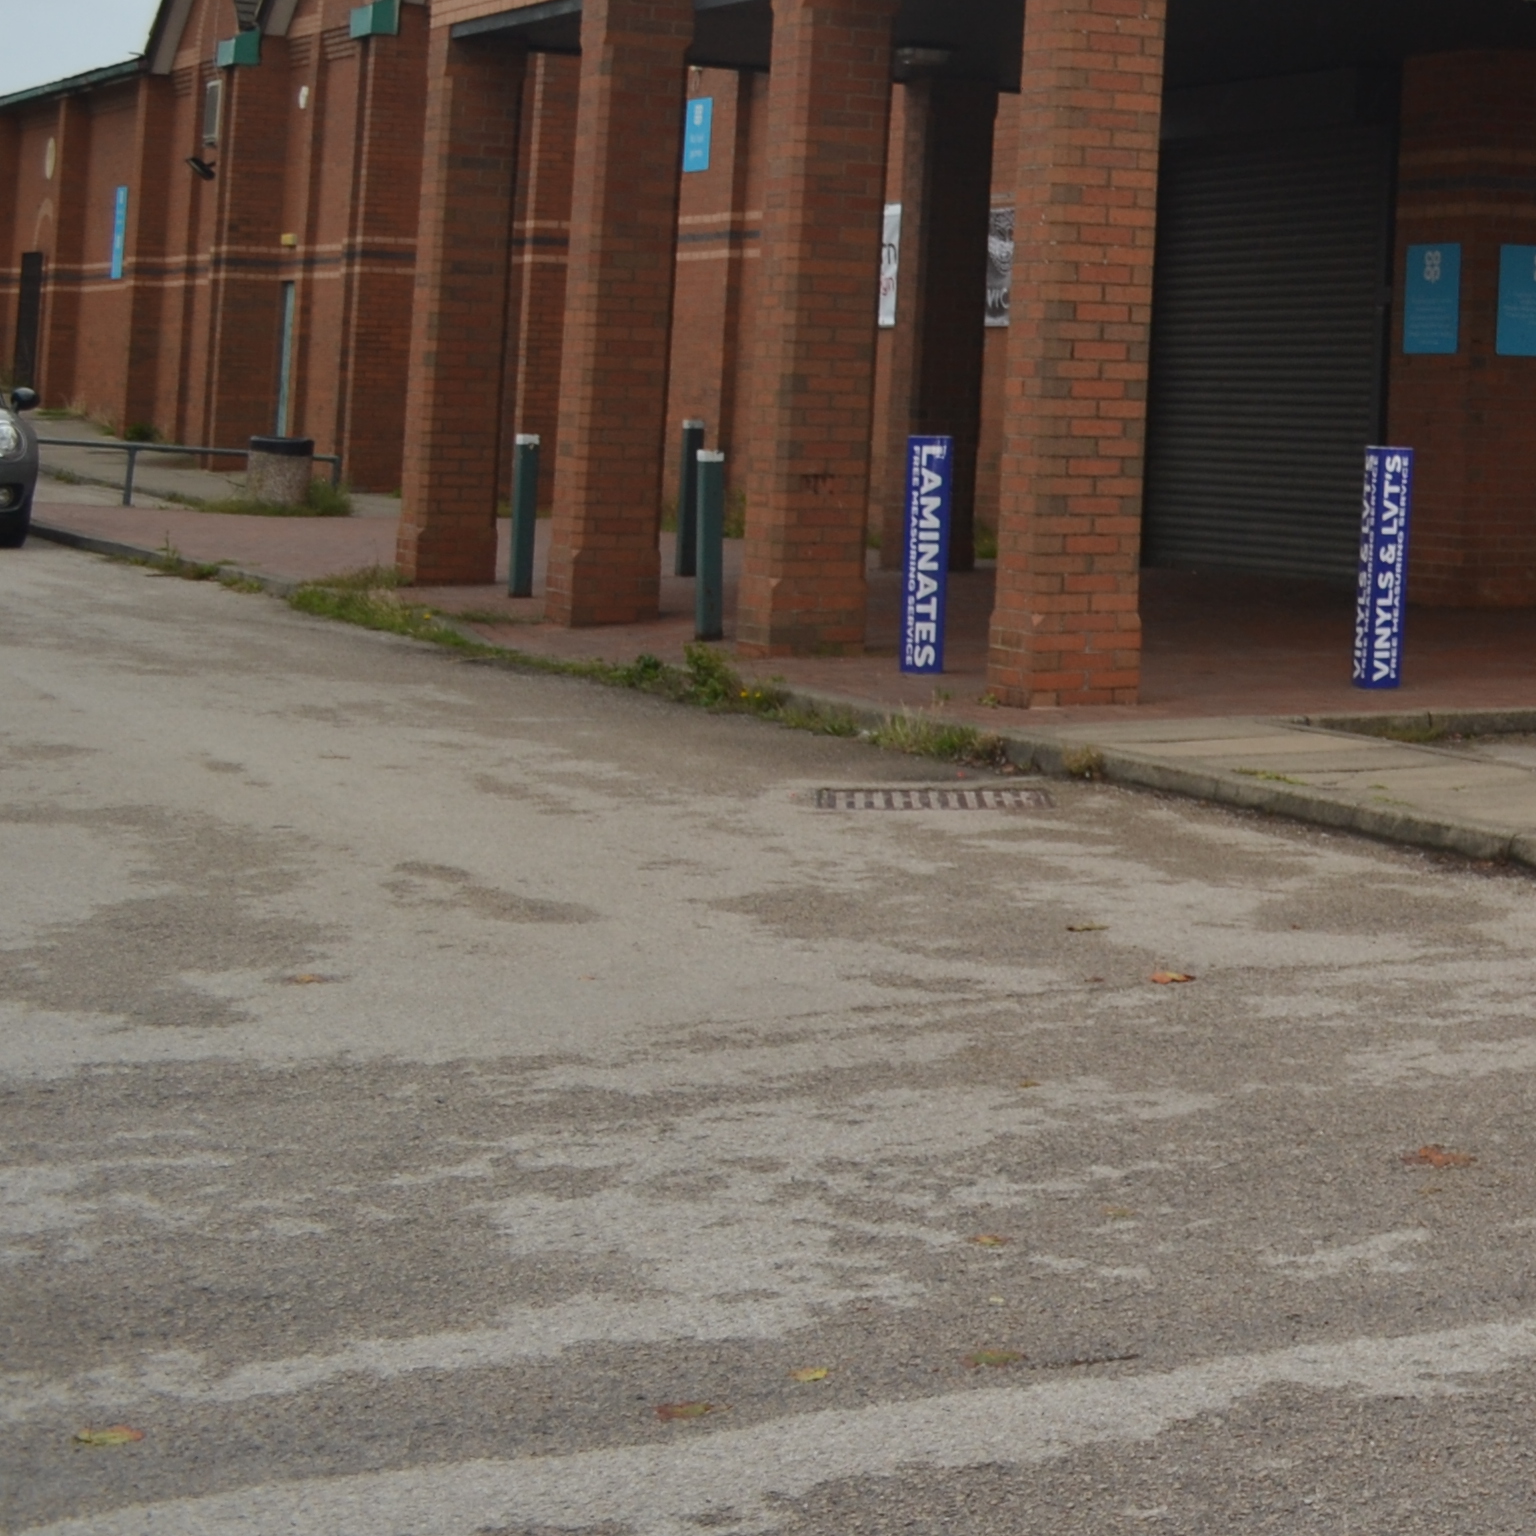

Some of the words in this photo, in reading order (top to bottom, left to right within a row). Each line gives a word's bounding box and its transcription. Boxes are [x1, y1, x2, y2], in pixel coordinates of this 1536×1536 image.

[912, 445, 920, 487] FREE
[1381, 454, 1401, 535] LVT'S
[1398, 456, 1409, 527] SERVICE
[908, 490, 919, 592] MEASURING
[914, 445, 943, 667] LAMINATES
[1379, 543, 1396, 564] &
[1392, 530, 1404, 633] MEASURING
[905, 595, 916, 666] SERVICE
[1372, 571, 1394, 681] VINYLS
[1389, 637, 1398, 679] FREE
